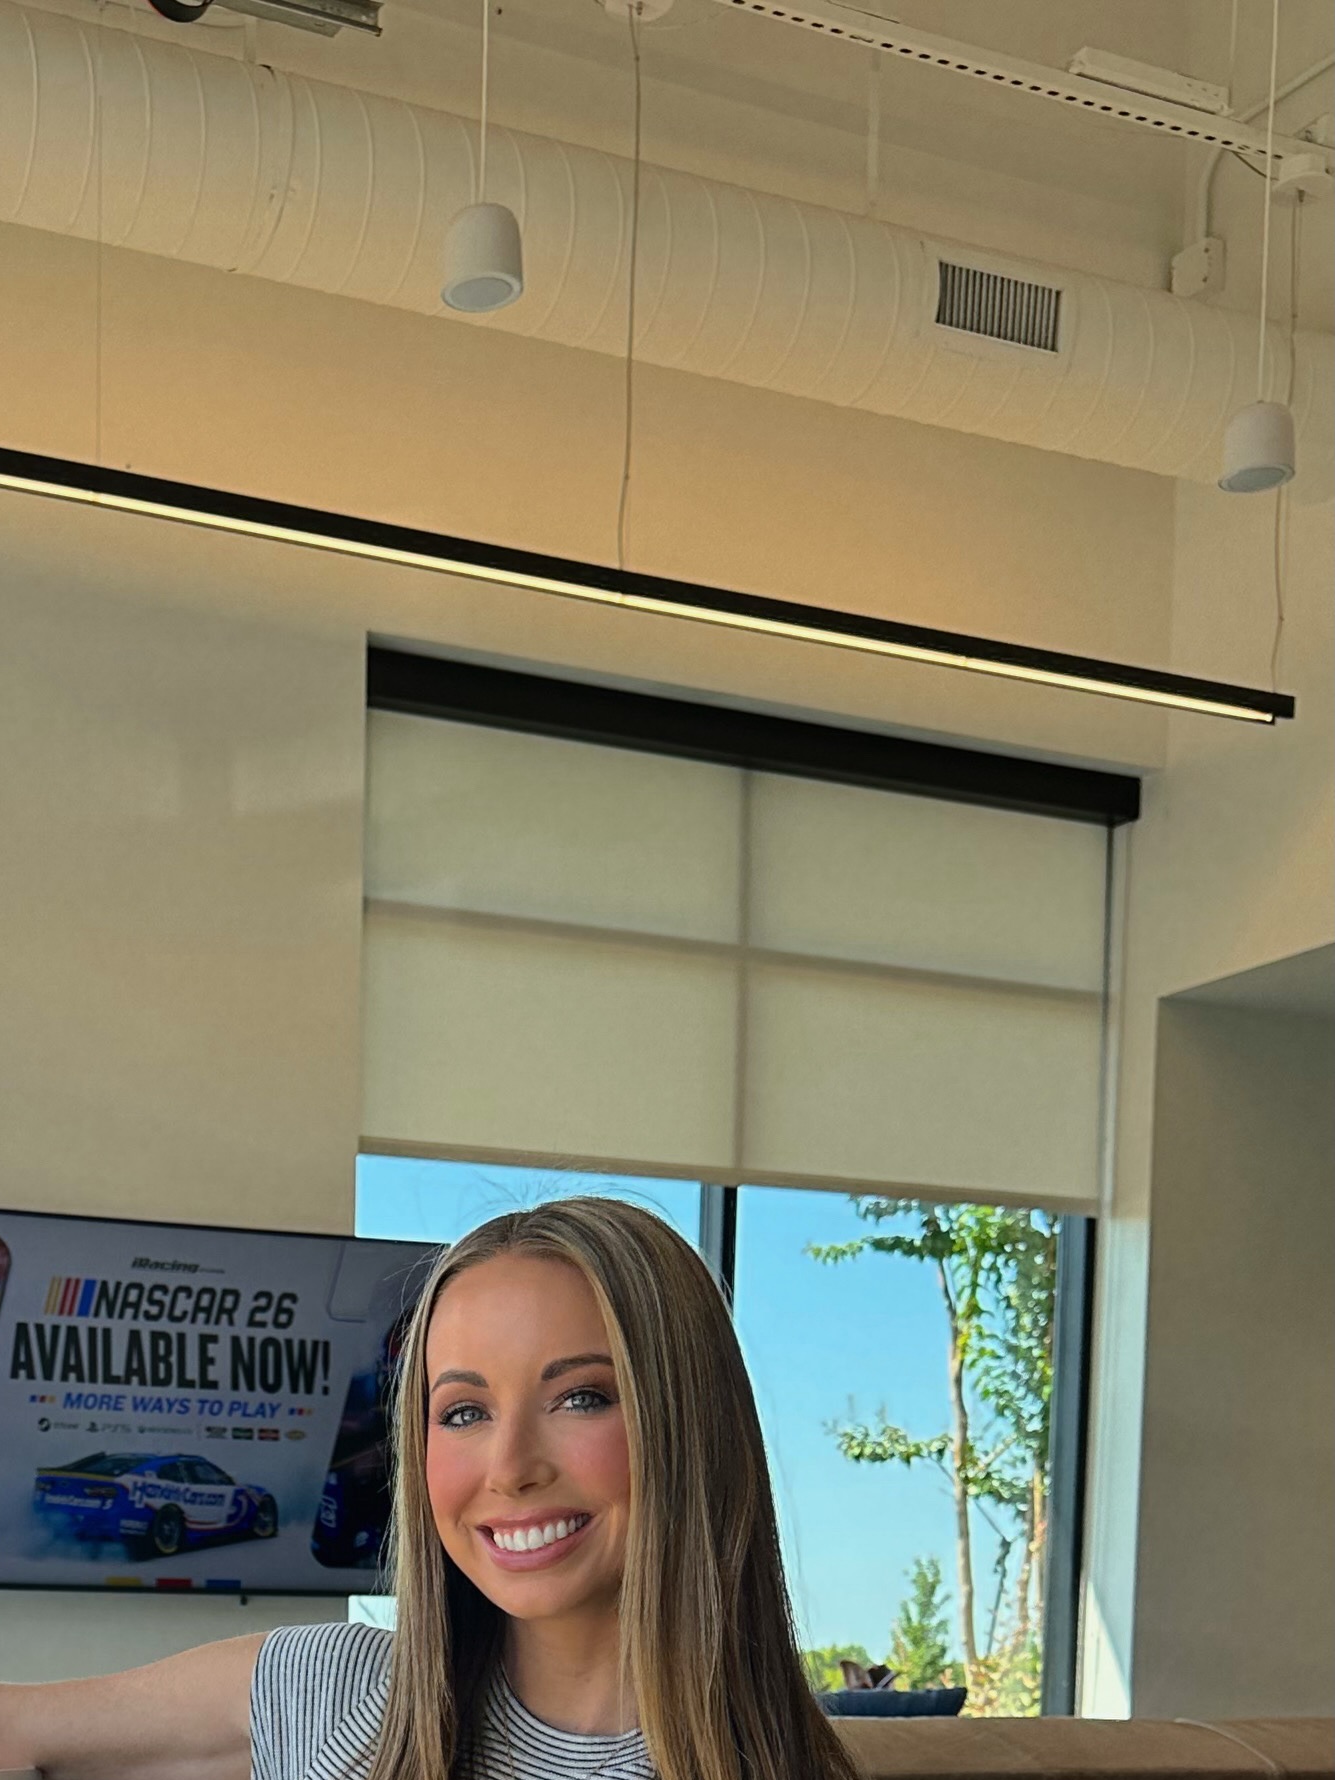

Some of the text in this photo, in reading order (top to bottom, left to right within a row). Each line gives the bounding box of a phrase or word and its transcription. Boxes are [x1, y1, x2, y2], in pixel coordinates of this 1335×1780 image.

[132, 1258, 199, 1273] iRacing
[94, 1280, 298, 1329] NASCAR 26
[10, 1321, 330, 1396] AVAILABLE NOW!
[64, 1393, 281, 1418] MORE WAYS TO PLAY
